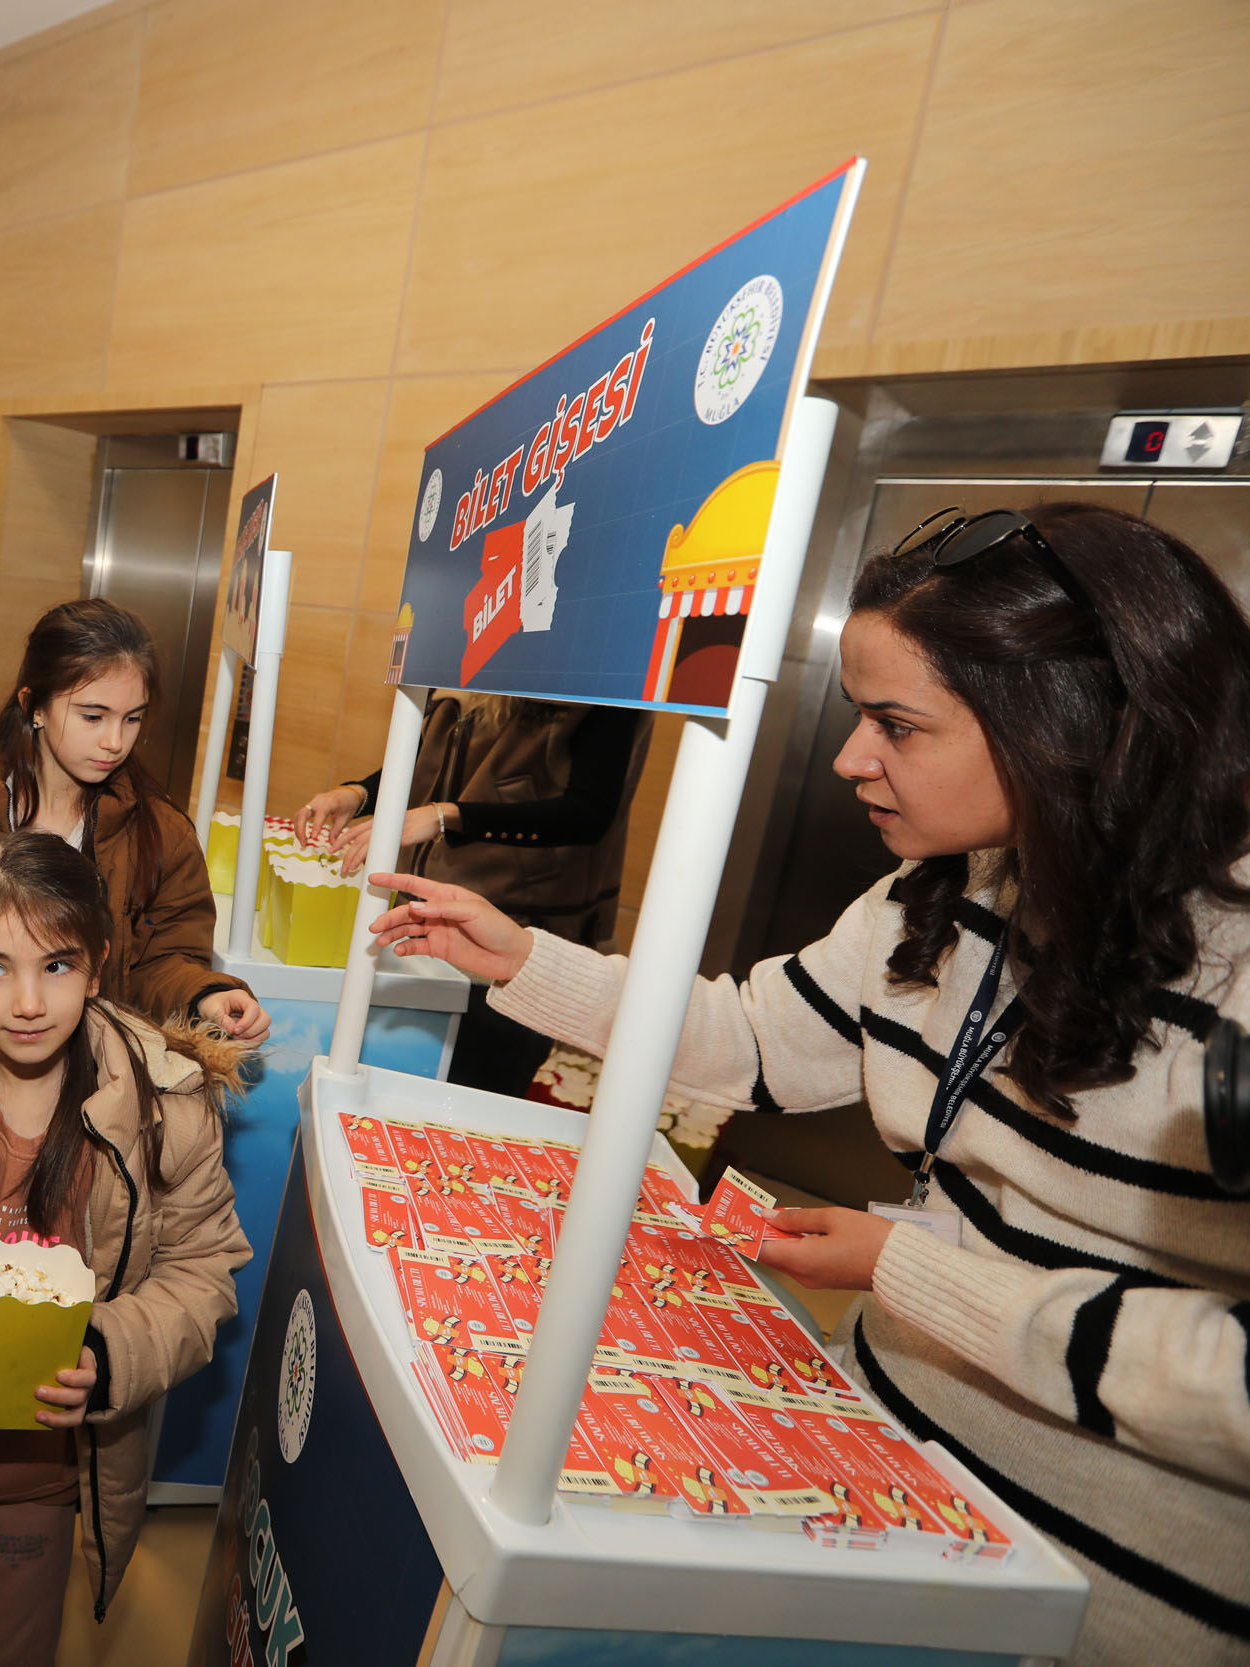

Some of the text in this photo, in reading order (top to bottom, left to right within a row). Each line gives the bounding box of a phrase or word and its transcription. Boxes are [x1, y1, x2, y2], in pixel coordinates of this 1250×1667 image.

[450, 444, 525, 552] BİLET
[521, 317, 656, 498] GİŞESİ
[472, 565, 517, 644] BİLET
[961, 1026, 975, 1048] MUĞLA
[976, 1044, 994, 1064] MUĞLA
